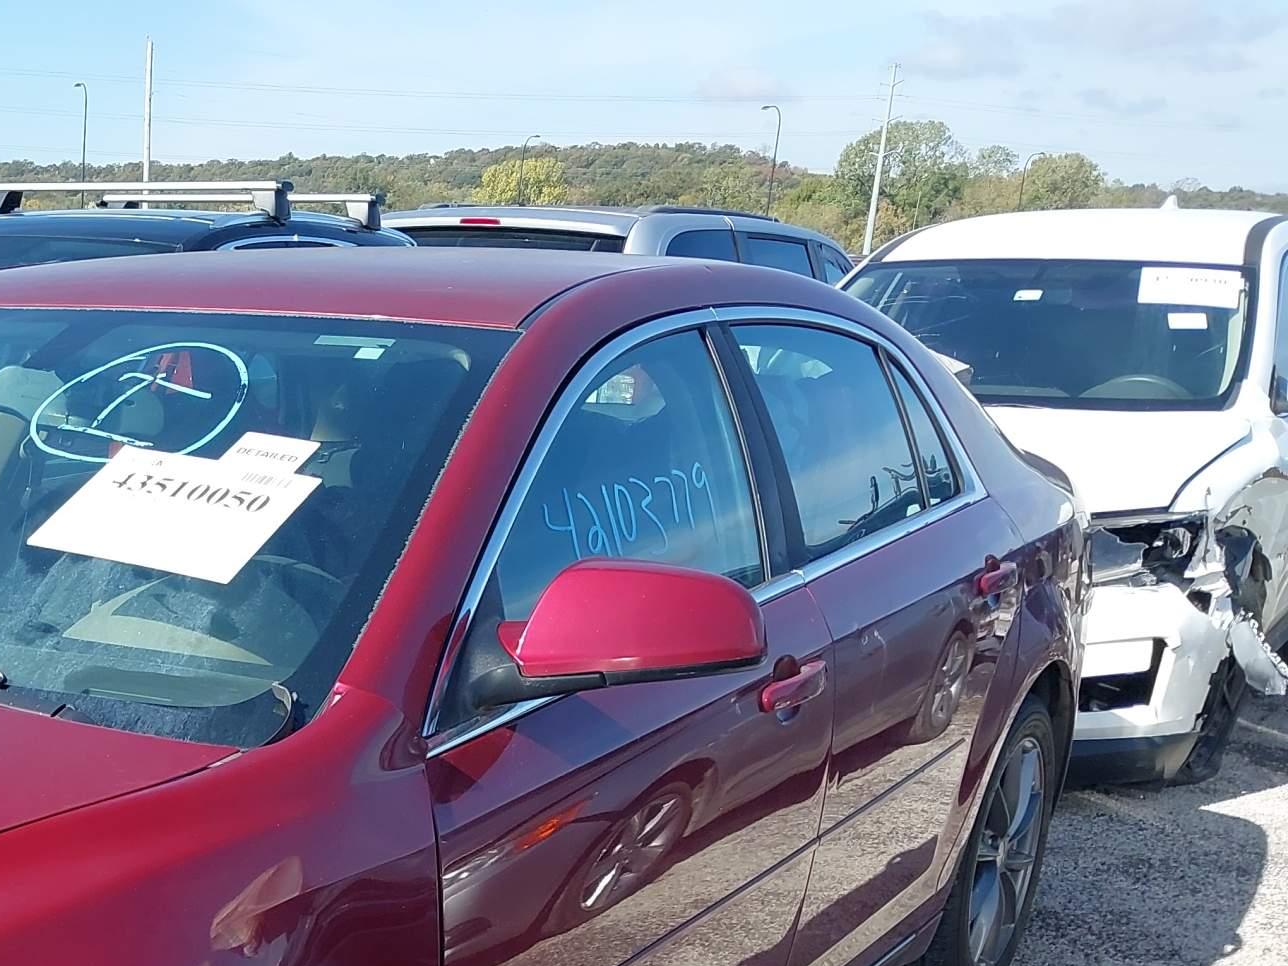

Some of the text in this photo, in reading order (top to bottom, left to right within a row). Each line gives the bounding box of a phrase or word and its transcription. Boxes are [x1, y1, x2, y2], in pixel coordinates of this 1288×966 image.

[236, 446, 299, 463] DETAILED
[112, 473, 270, 513] 43510050
[542, 461, 720, 560] 42103779
